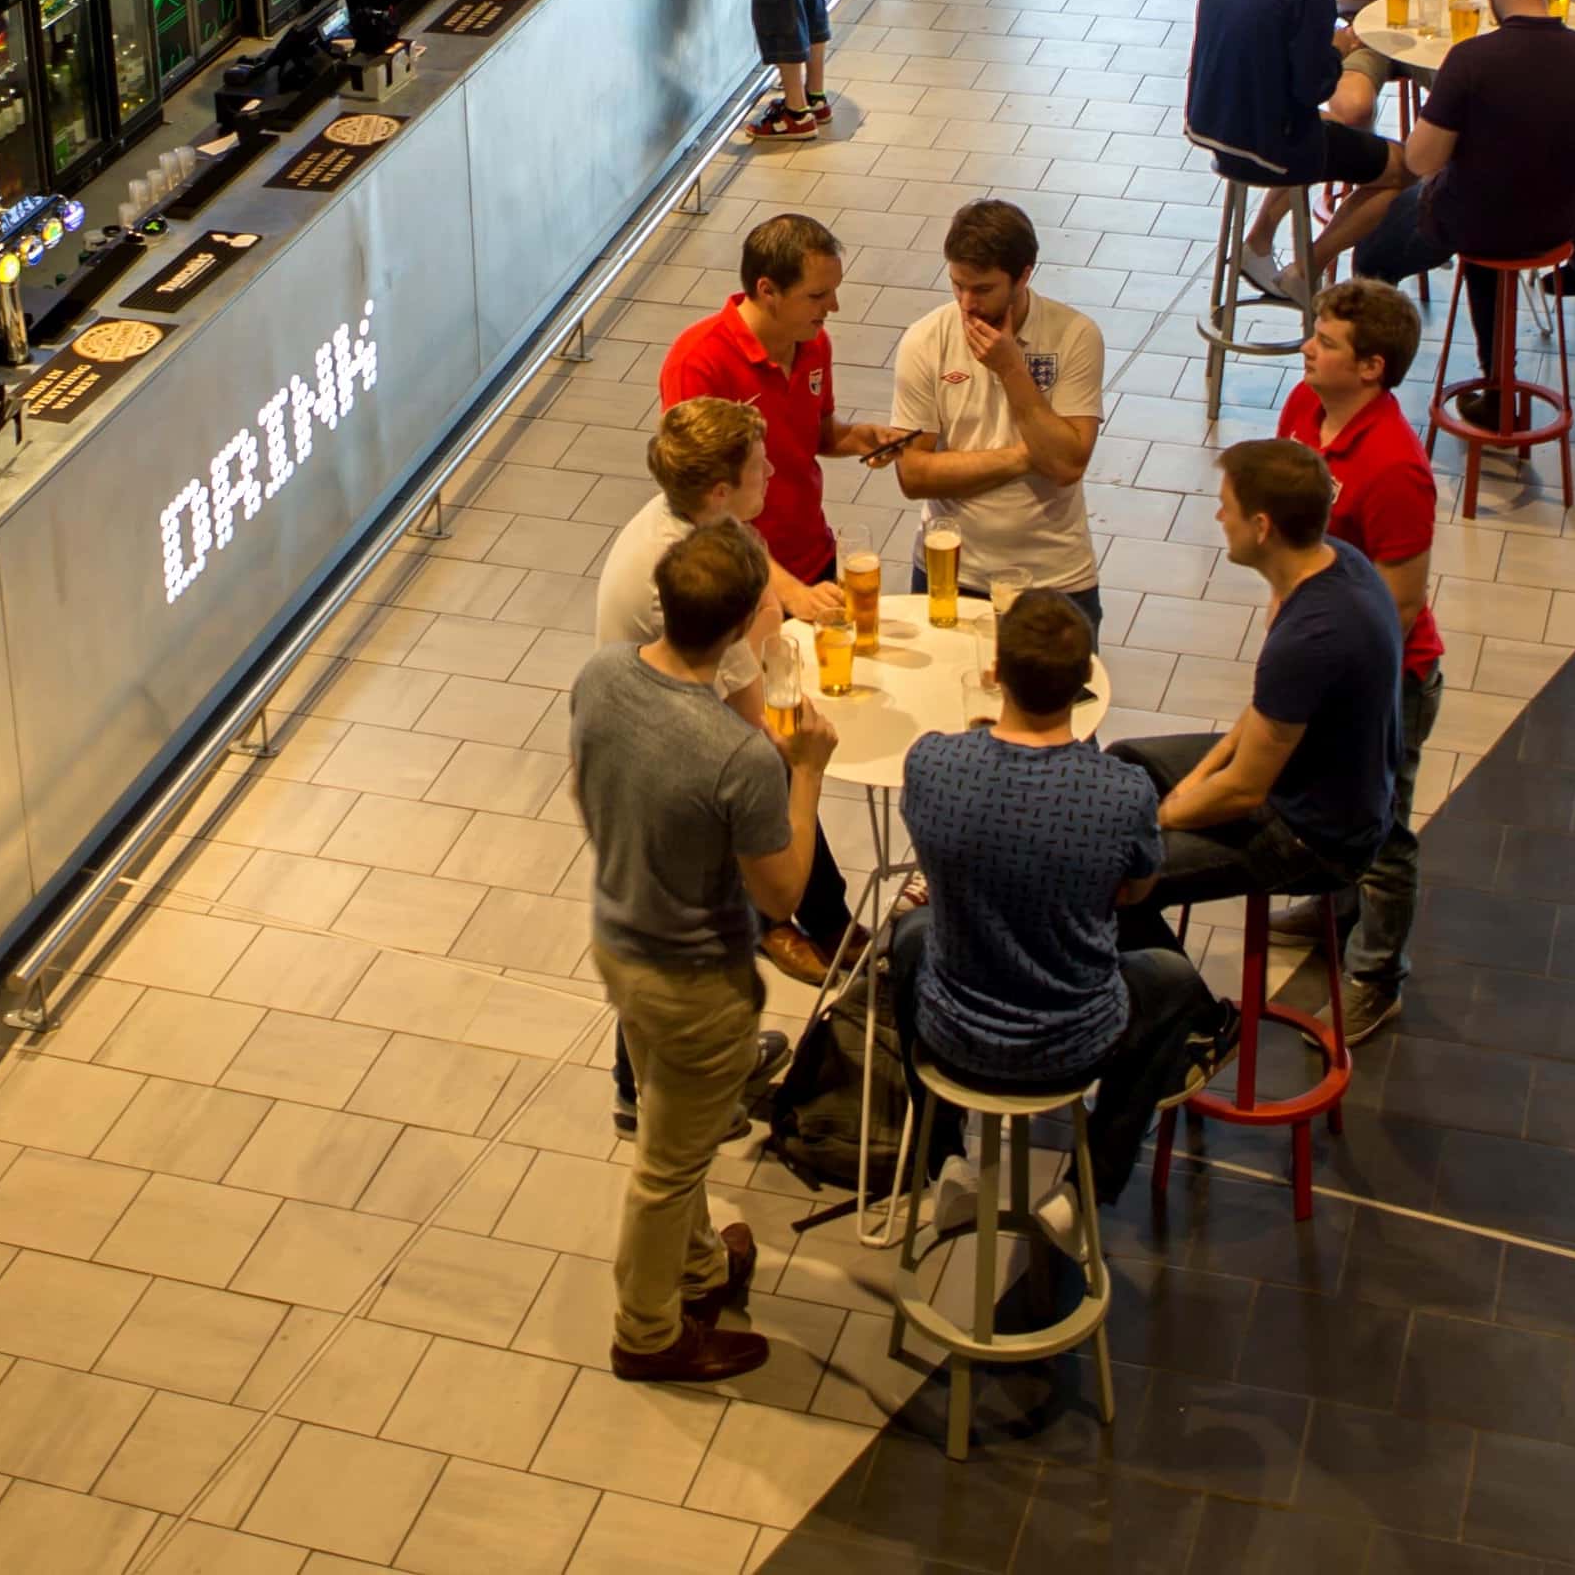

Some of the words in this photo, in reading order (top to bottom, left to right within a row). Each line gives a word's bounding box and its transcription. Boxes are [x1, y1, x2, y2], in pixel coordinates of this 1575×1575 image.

[23, 379, 54, 401] RIDE
[45, 368, 67, 381] IN
[26, 363, 93, 416] EVERYTHING
[50, 395, 76, 410] WE
[68, 371, 103, 398] BREW
[160, 299, 377, 604] DRINK
